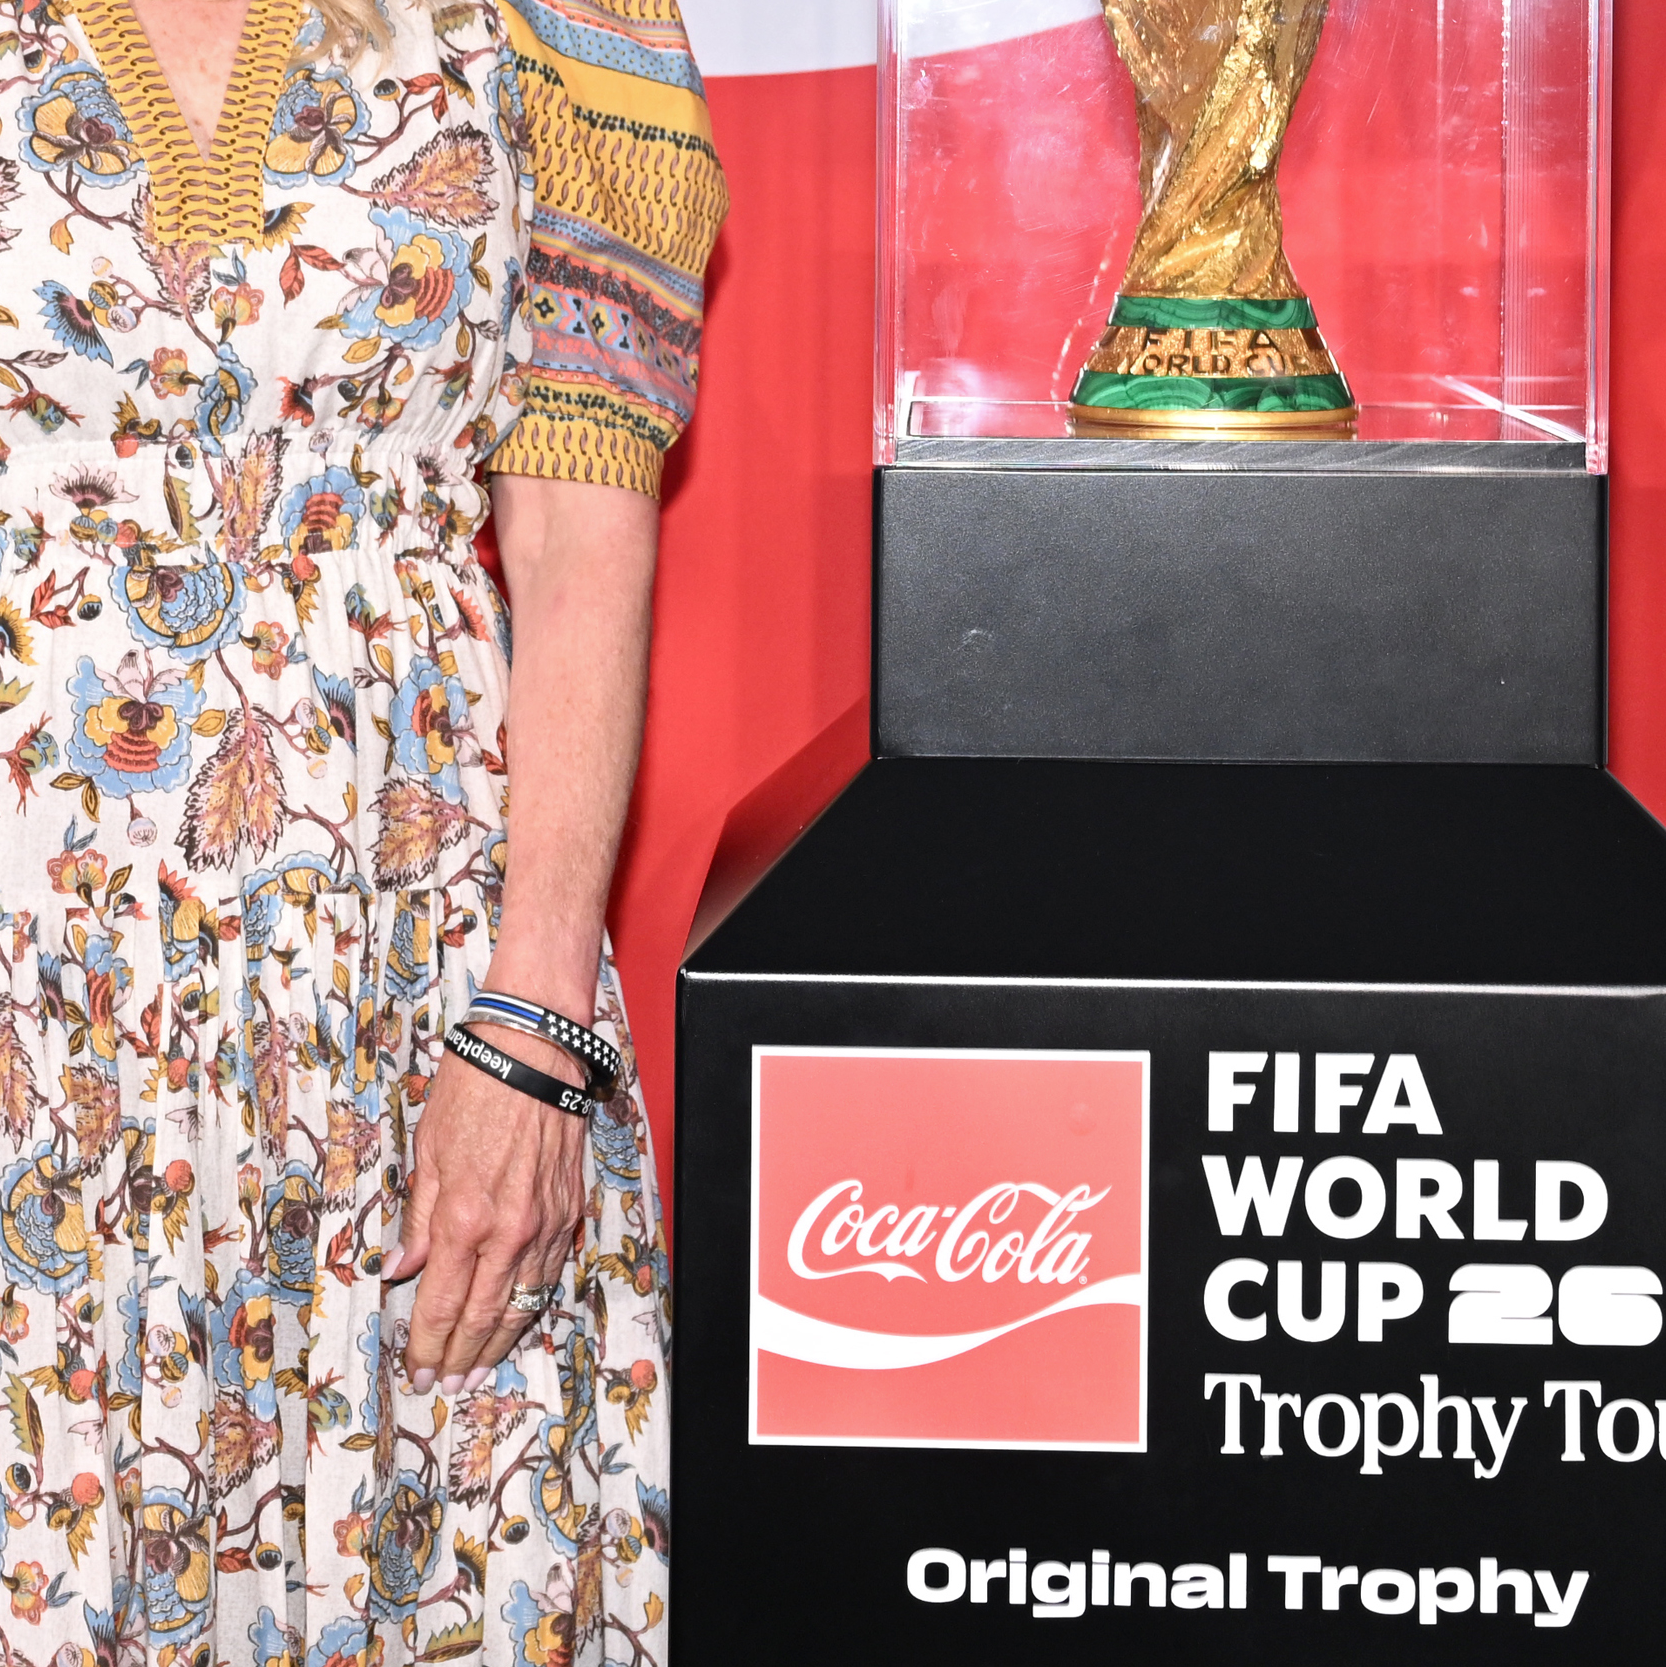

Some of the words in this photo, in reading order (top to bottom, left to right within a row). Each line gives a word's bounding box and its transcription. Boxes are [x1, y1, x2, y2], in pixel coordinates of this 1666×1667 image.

[1144, 328, 1281, 350] FIFA
[558, 1089, 595, 1115] 8-25
[1209, 1052, 1442, 1134] FIFA
[787, 1179, 1112, 1285] Coca-Cola
[1202, 1156, 1608, 1240] WORLD
[1204, 1259, 1423, 1342] CUP
[1205, 1374, 1527, 1478] Trophy
[907, 1549, 1247, 1618] Original
[1268, 1556, 1590, 1628] Trophy
